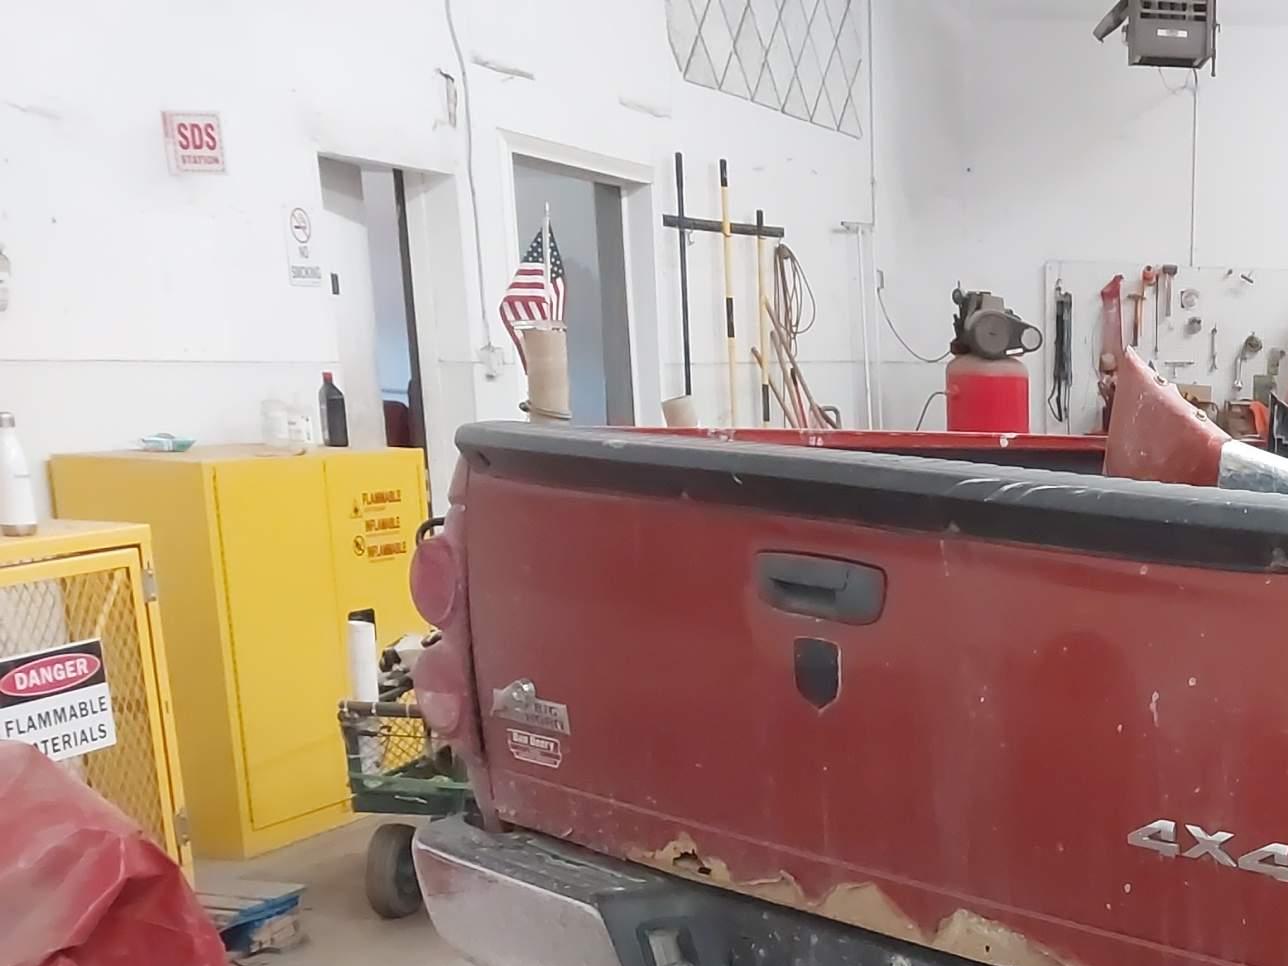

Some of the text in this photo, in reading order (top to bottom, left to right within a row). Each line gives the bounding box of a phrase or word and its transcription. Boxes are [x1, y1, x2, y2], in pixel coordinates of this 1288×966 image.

[177, 122, 217, 151] SDS
[181, 154, 220, 166] STATION
[298, 245, 309, 259] NO
[291, 264, 322, 280] SMOKING
[361, 489, 402, 505] FLAMMABLE
[14, 657, 89, 691] DANGER
[4, 695, 108, 738] FLAMMABLE
[33, 723, 108, 755] TERIALS
